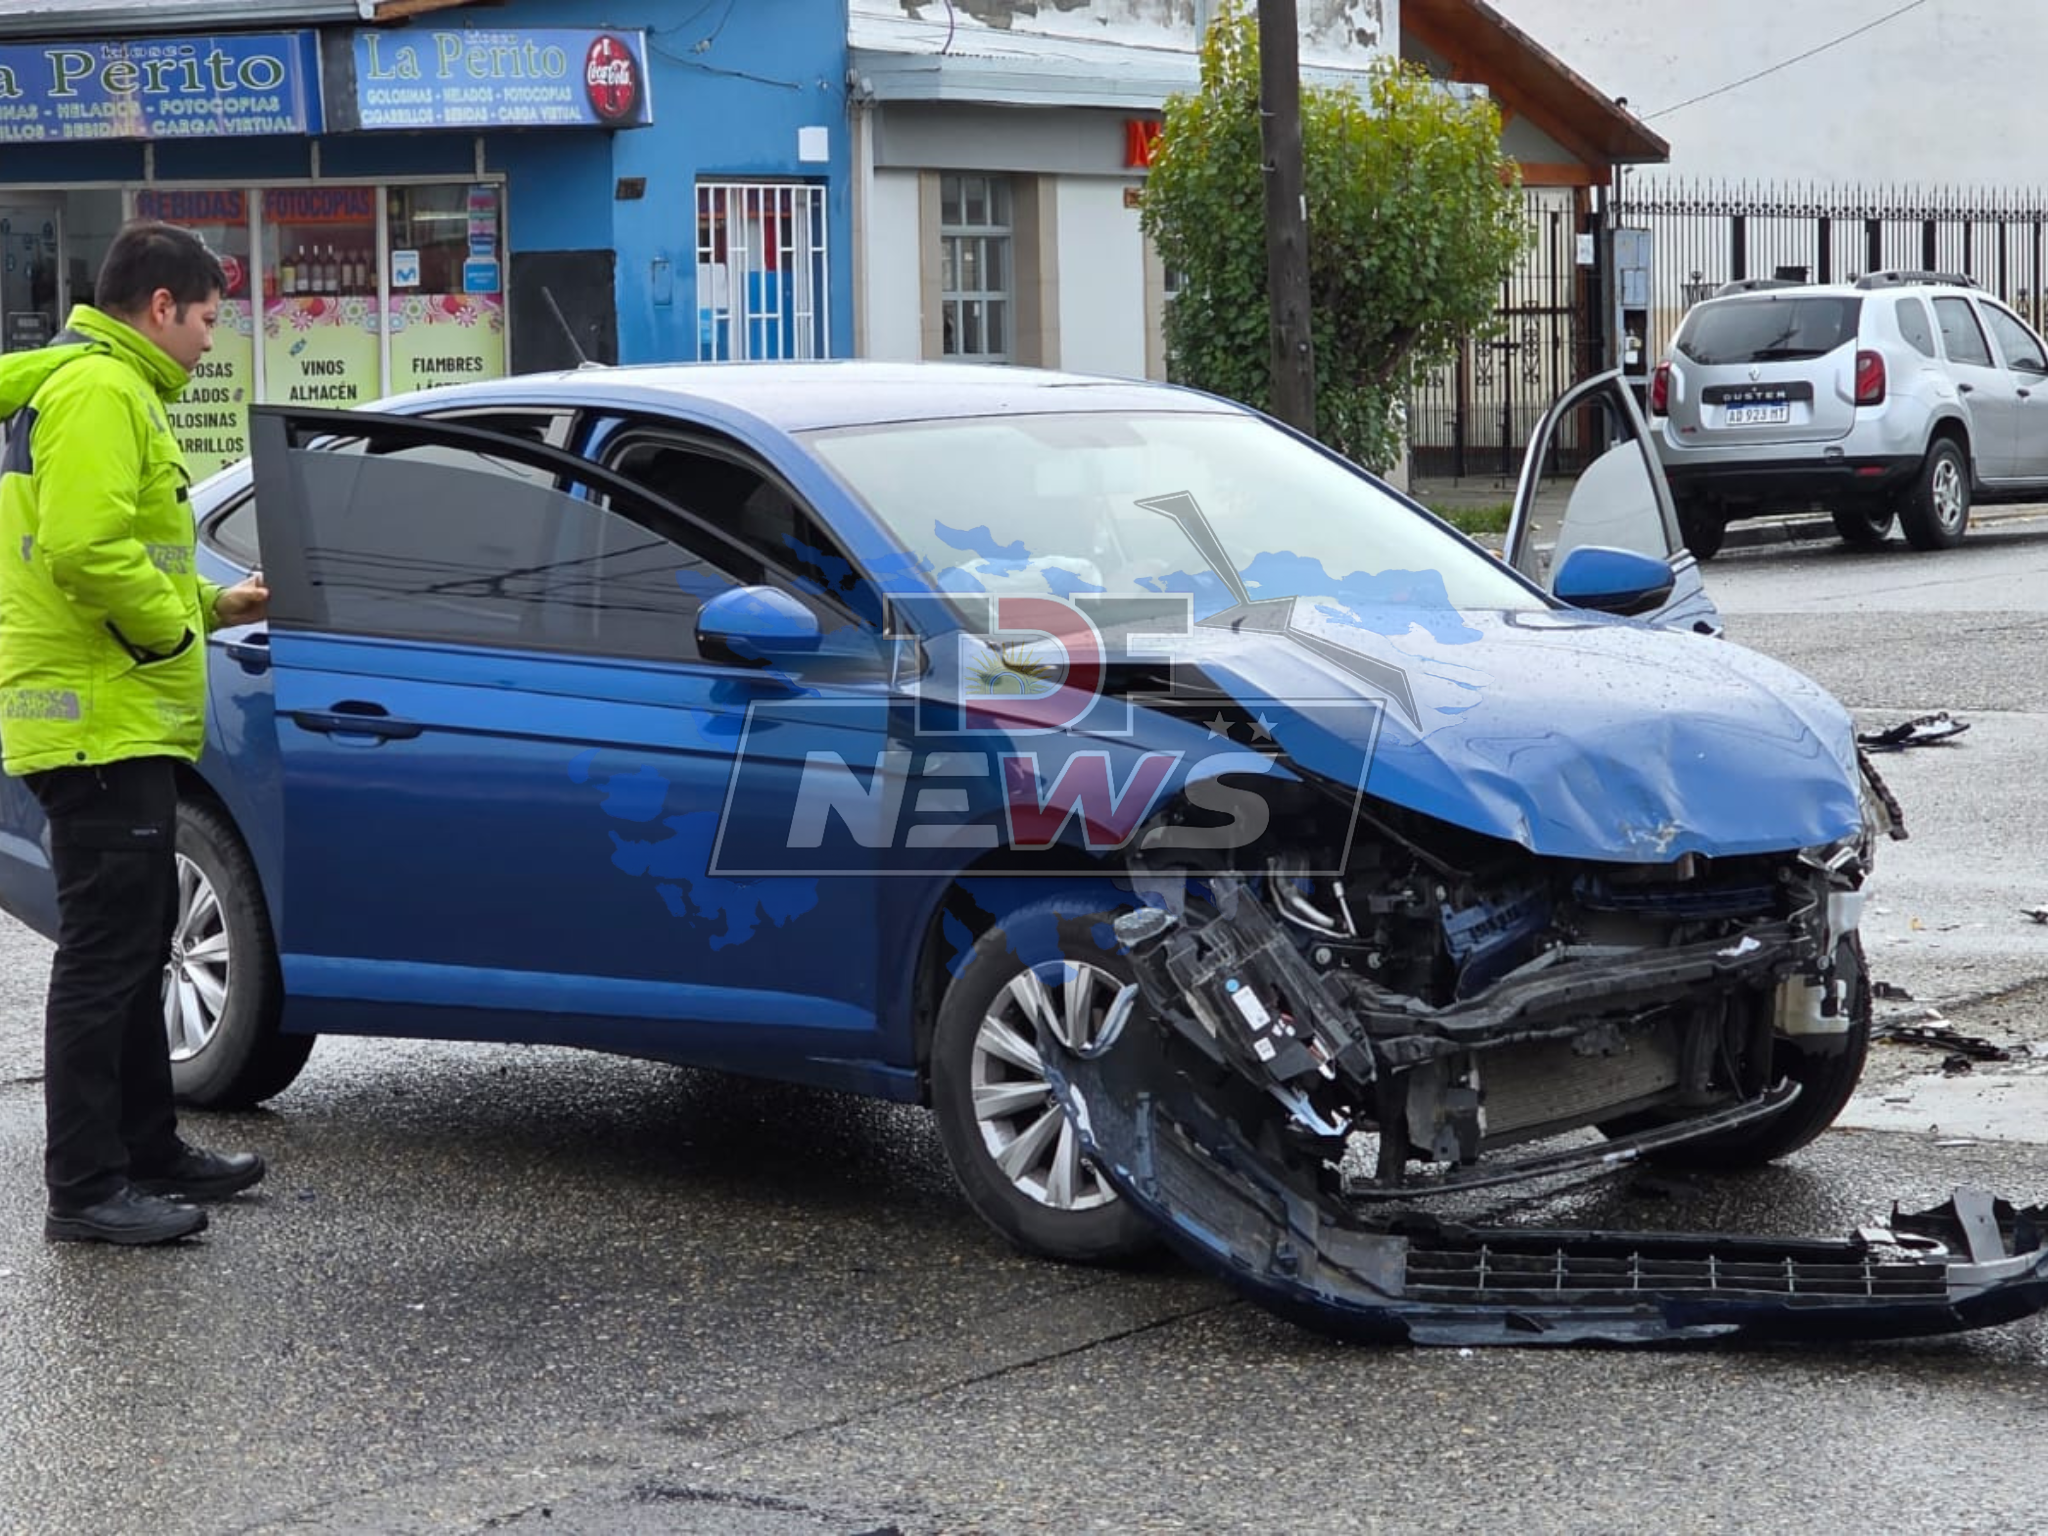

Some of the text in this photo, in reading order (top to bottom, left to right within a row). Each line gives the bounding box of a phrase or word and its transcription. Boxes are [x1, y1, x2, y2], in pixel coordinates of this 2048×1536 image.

[364, 31, 567, 80] La Perito
[45, 46, 285, 97] Perito
[57, 102, 140, 119] HELADOS
[160, 96, 280, 115] FOTOCOPIAS
[153, 118, 219, 136] CARGA
[223, 116, 296, 133] VIRTUAL
[136, 189, 370, 219] BEBIDAS FOTOCOPIAS
[192, 362, 233, 379] OSAS
[301, 359, 345, 376] VINOS
[412, 356, 483, 374] FIAMBRES
[175, 387, 230, 404] LADOS
[1723, 391, 1786, 400] DUSTER
[168, 413, 238, 429] OLOSINAS
[179, 437, 244, 453] ARRILLOS
